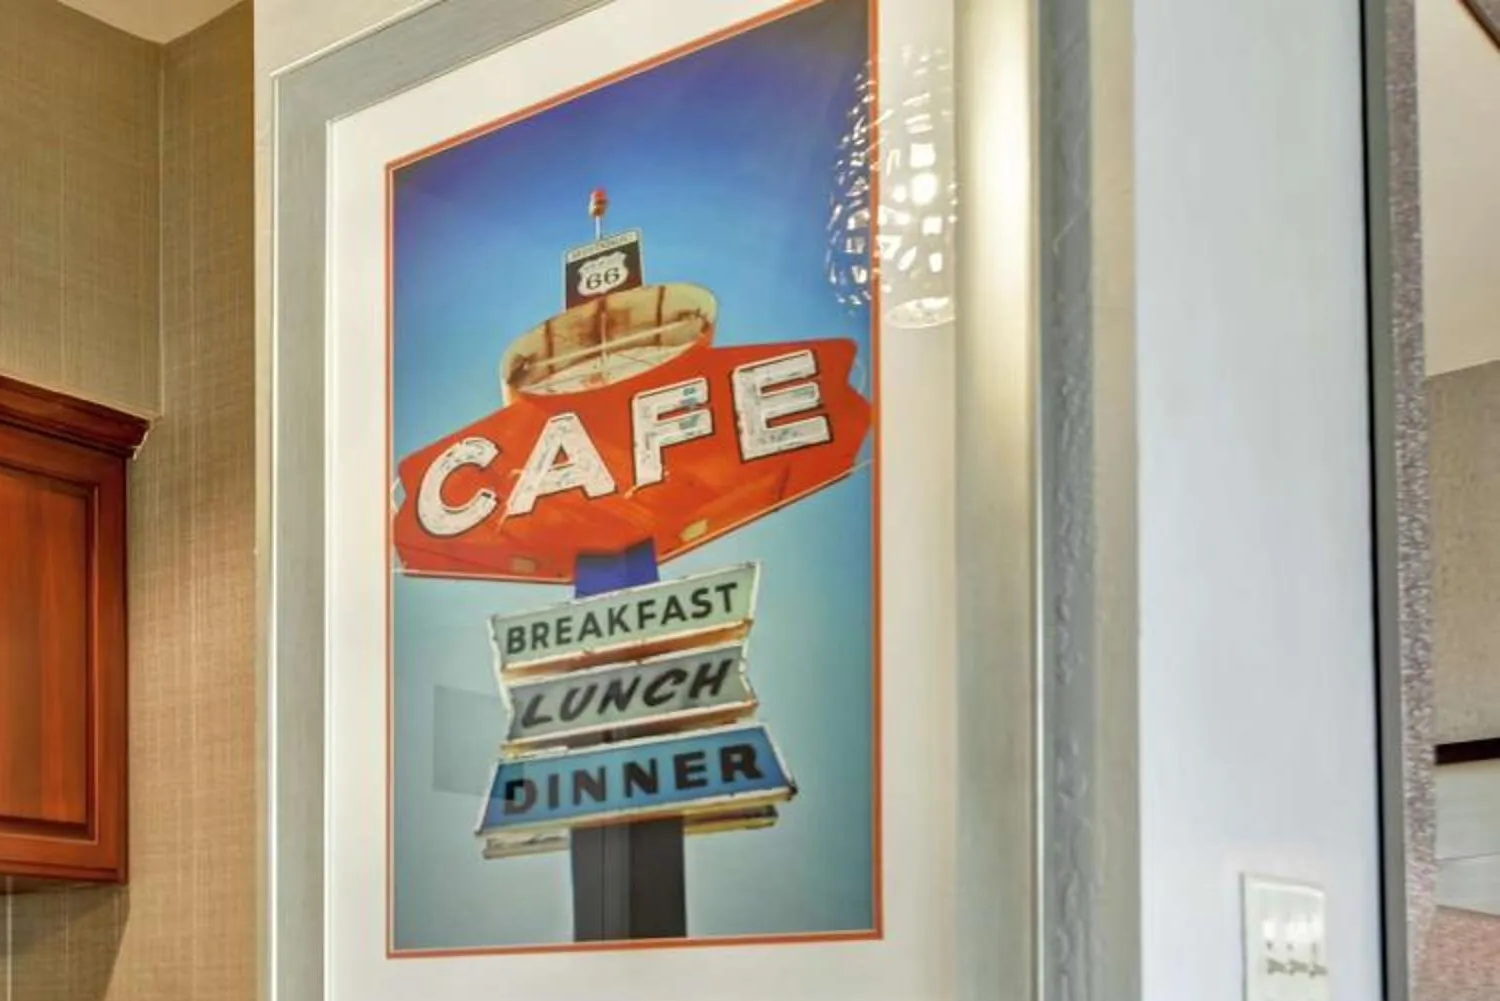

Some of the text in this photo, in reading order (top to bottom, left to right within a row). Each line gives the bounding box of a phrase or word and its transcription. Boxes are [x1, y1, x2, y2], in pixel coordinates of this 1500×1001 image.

[586, 267, 620, 290] 66
[417, 349, 832, 538] CAFE
[506, 583, 738, 654] BREAKFAST
[521, 659, 732, 728] LUNCH
[504, 744, 766, 816] DINNER
